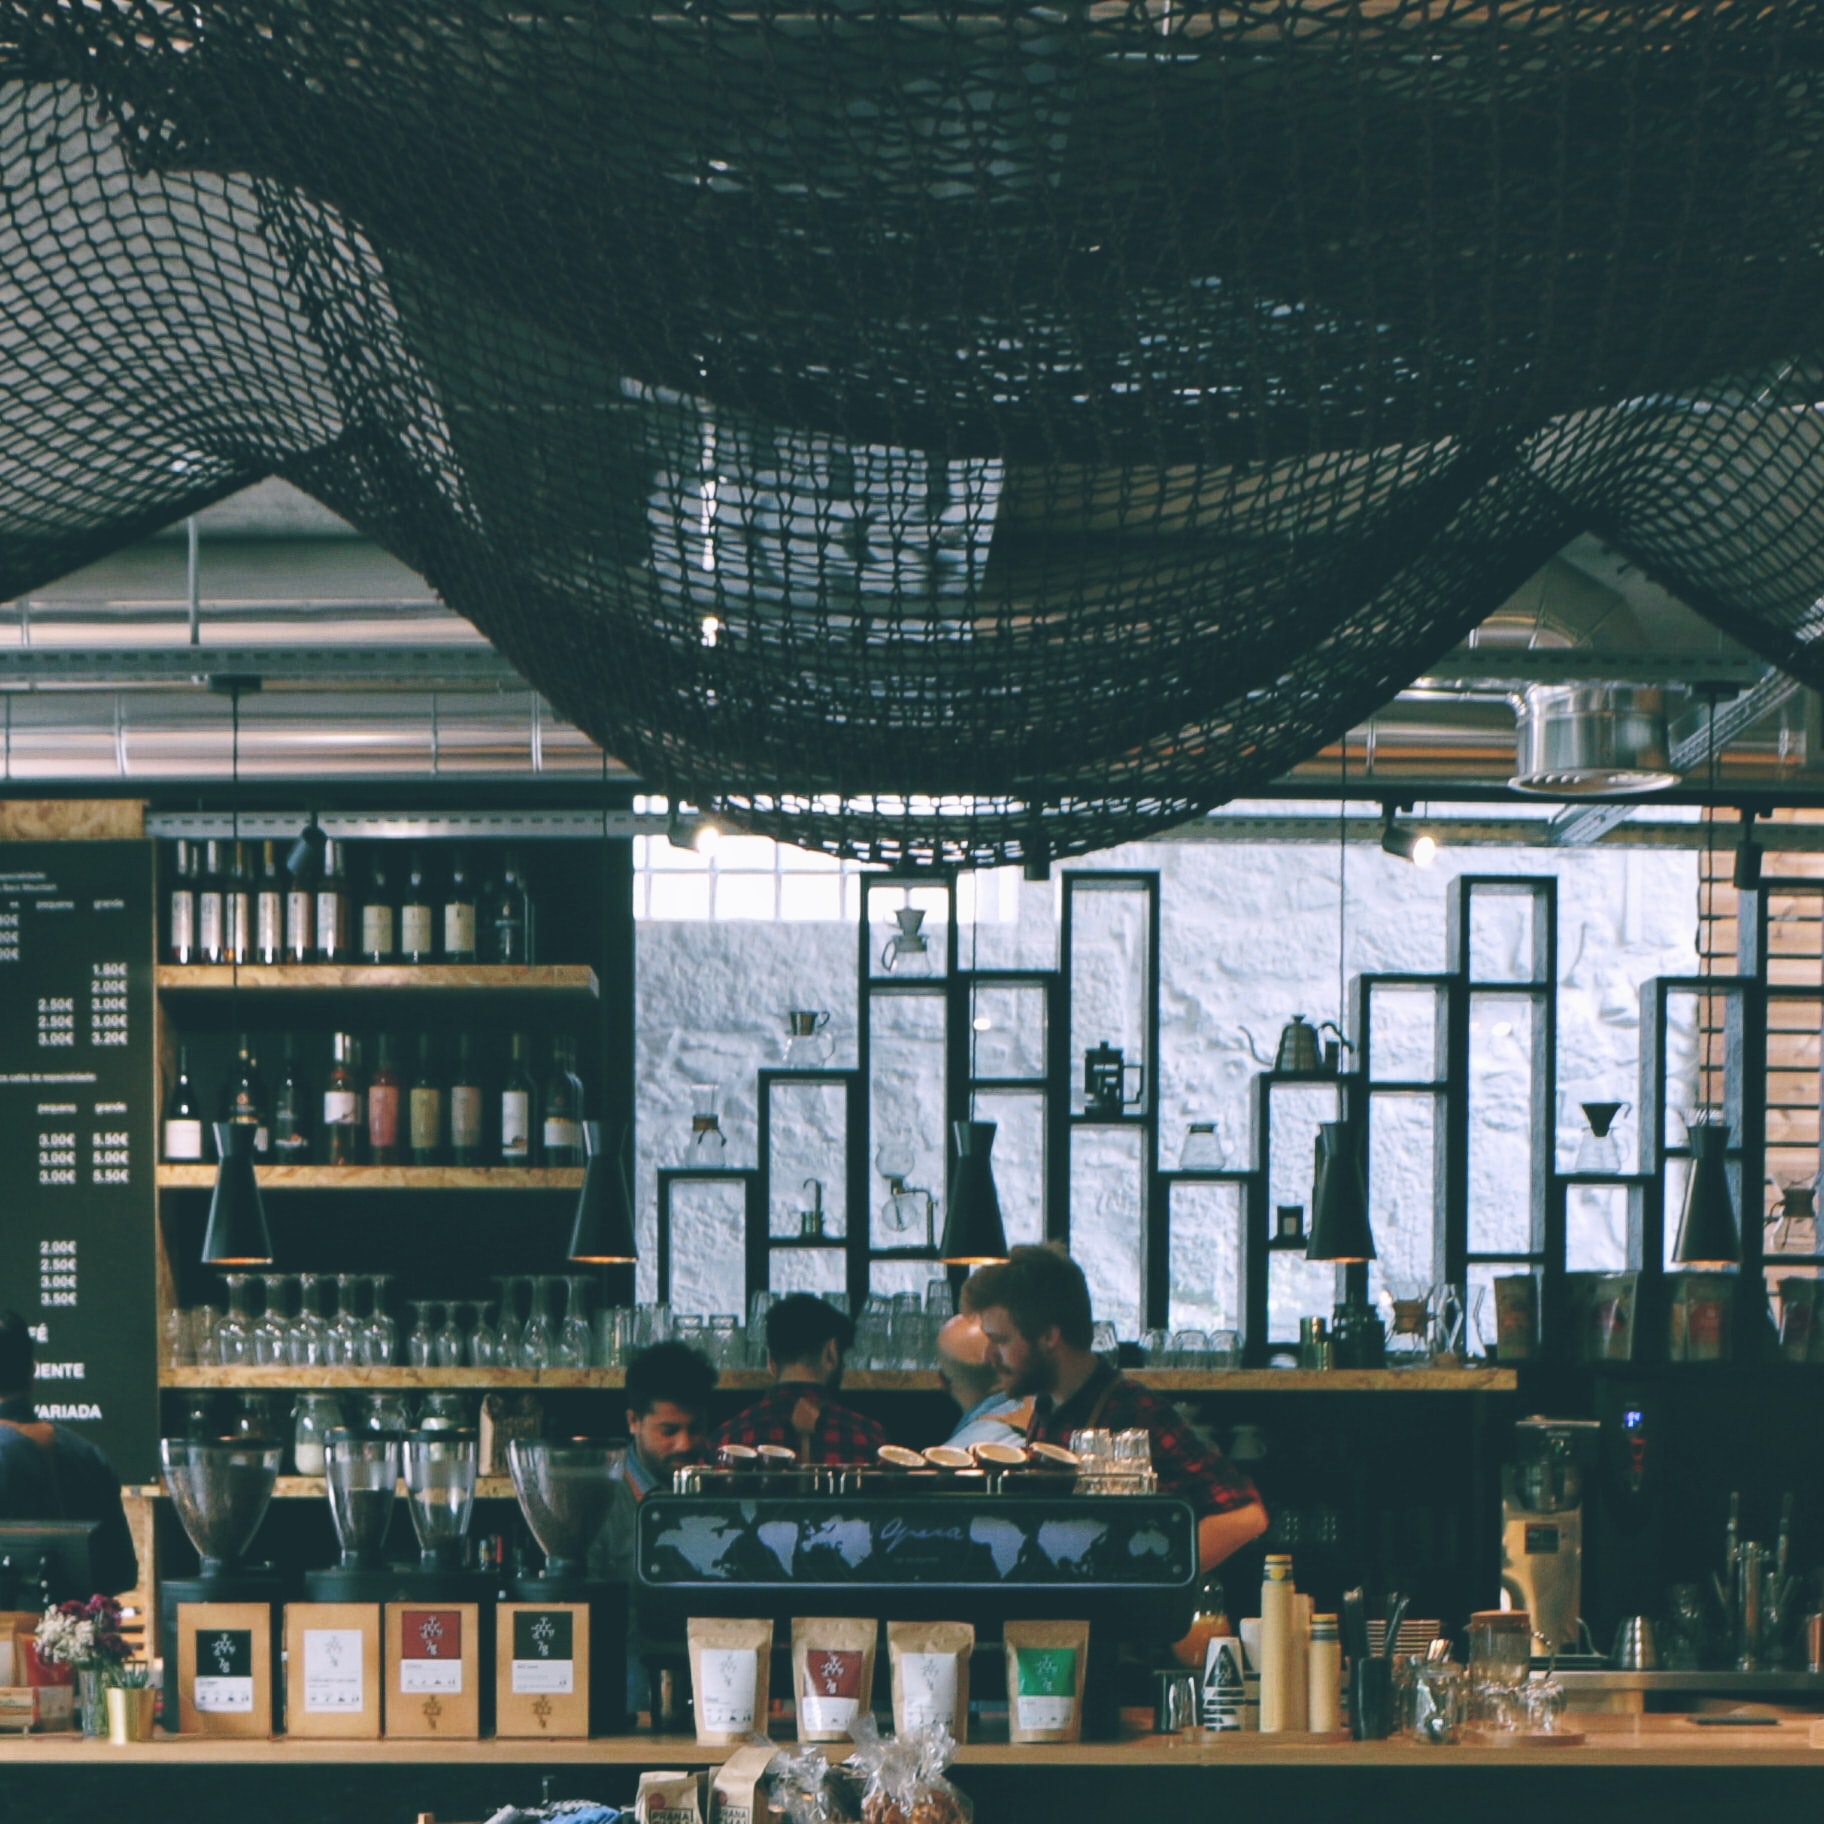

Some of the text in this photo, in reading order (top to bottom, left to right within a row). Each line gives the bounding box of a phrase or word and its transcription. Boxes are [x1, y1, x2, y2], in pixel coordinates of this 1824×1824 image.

[91, 980, 128, 994] 2.00€
[91, 998, 128, 1011] 3.00€
[91, 1015, 128, 1028] 3.00€
[38, 1033, 75, 1046] 3.00€
[91, 1032, 129, 1046] 3.20€
[39, 1133, 75, 1147] 3.00€
[39, 1151, 76, 1165] 3.00€
[39, 1169, 76, 1184] 3.00€
[40, 1240, 77, 1255] 2.00€
[40, 1275, 77, 1289] 3.00€
[34, 1404, 102, 1420] ARIADA
